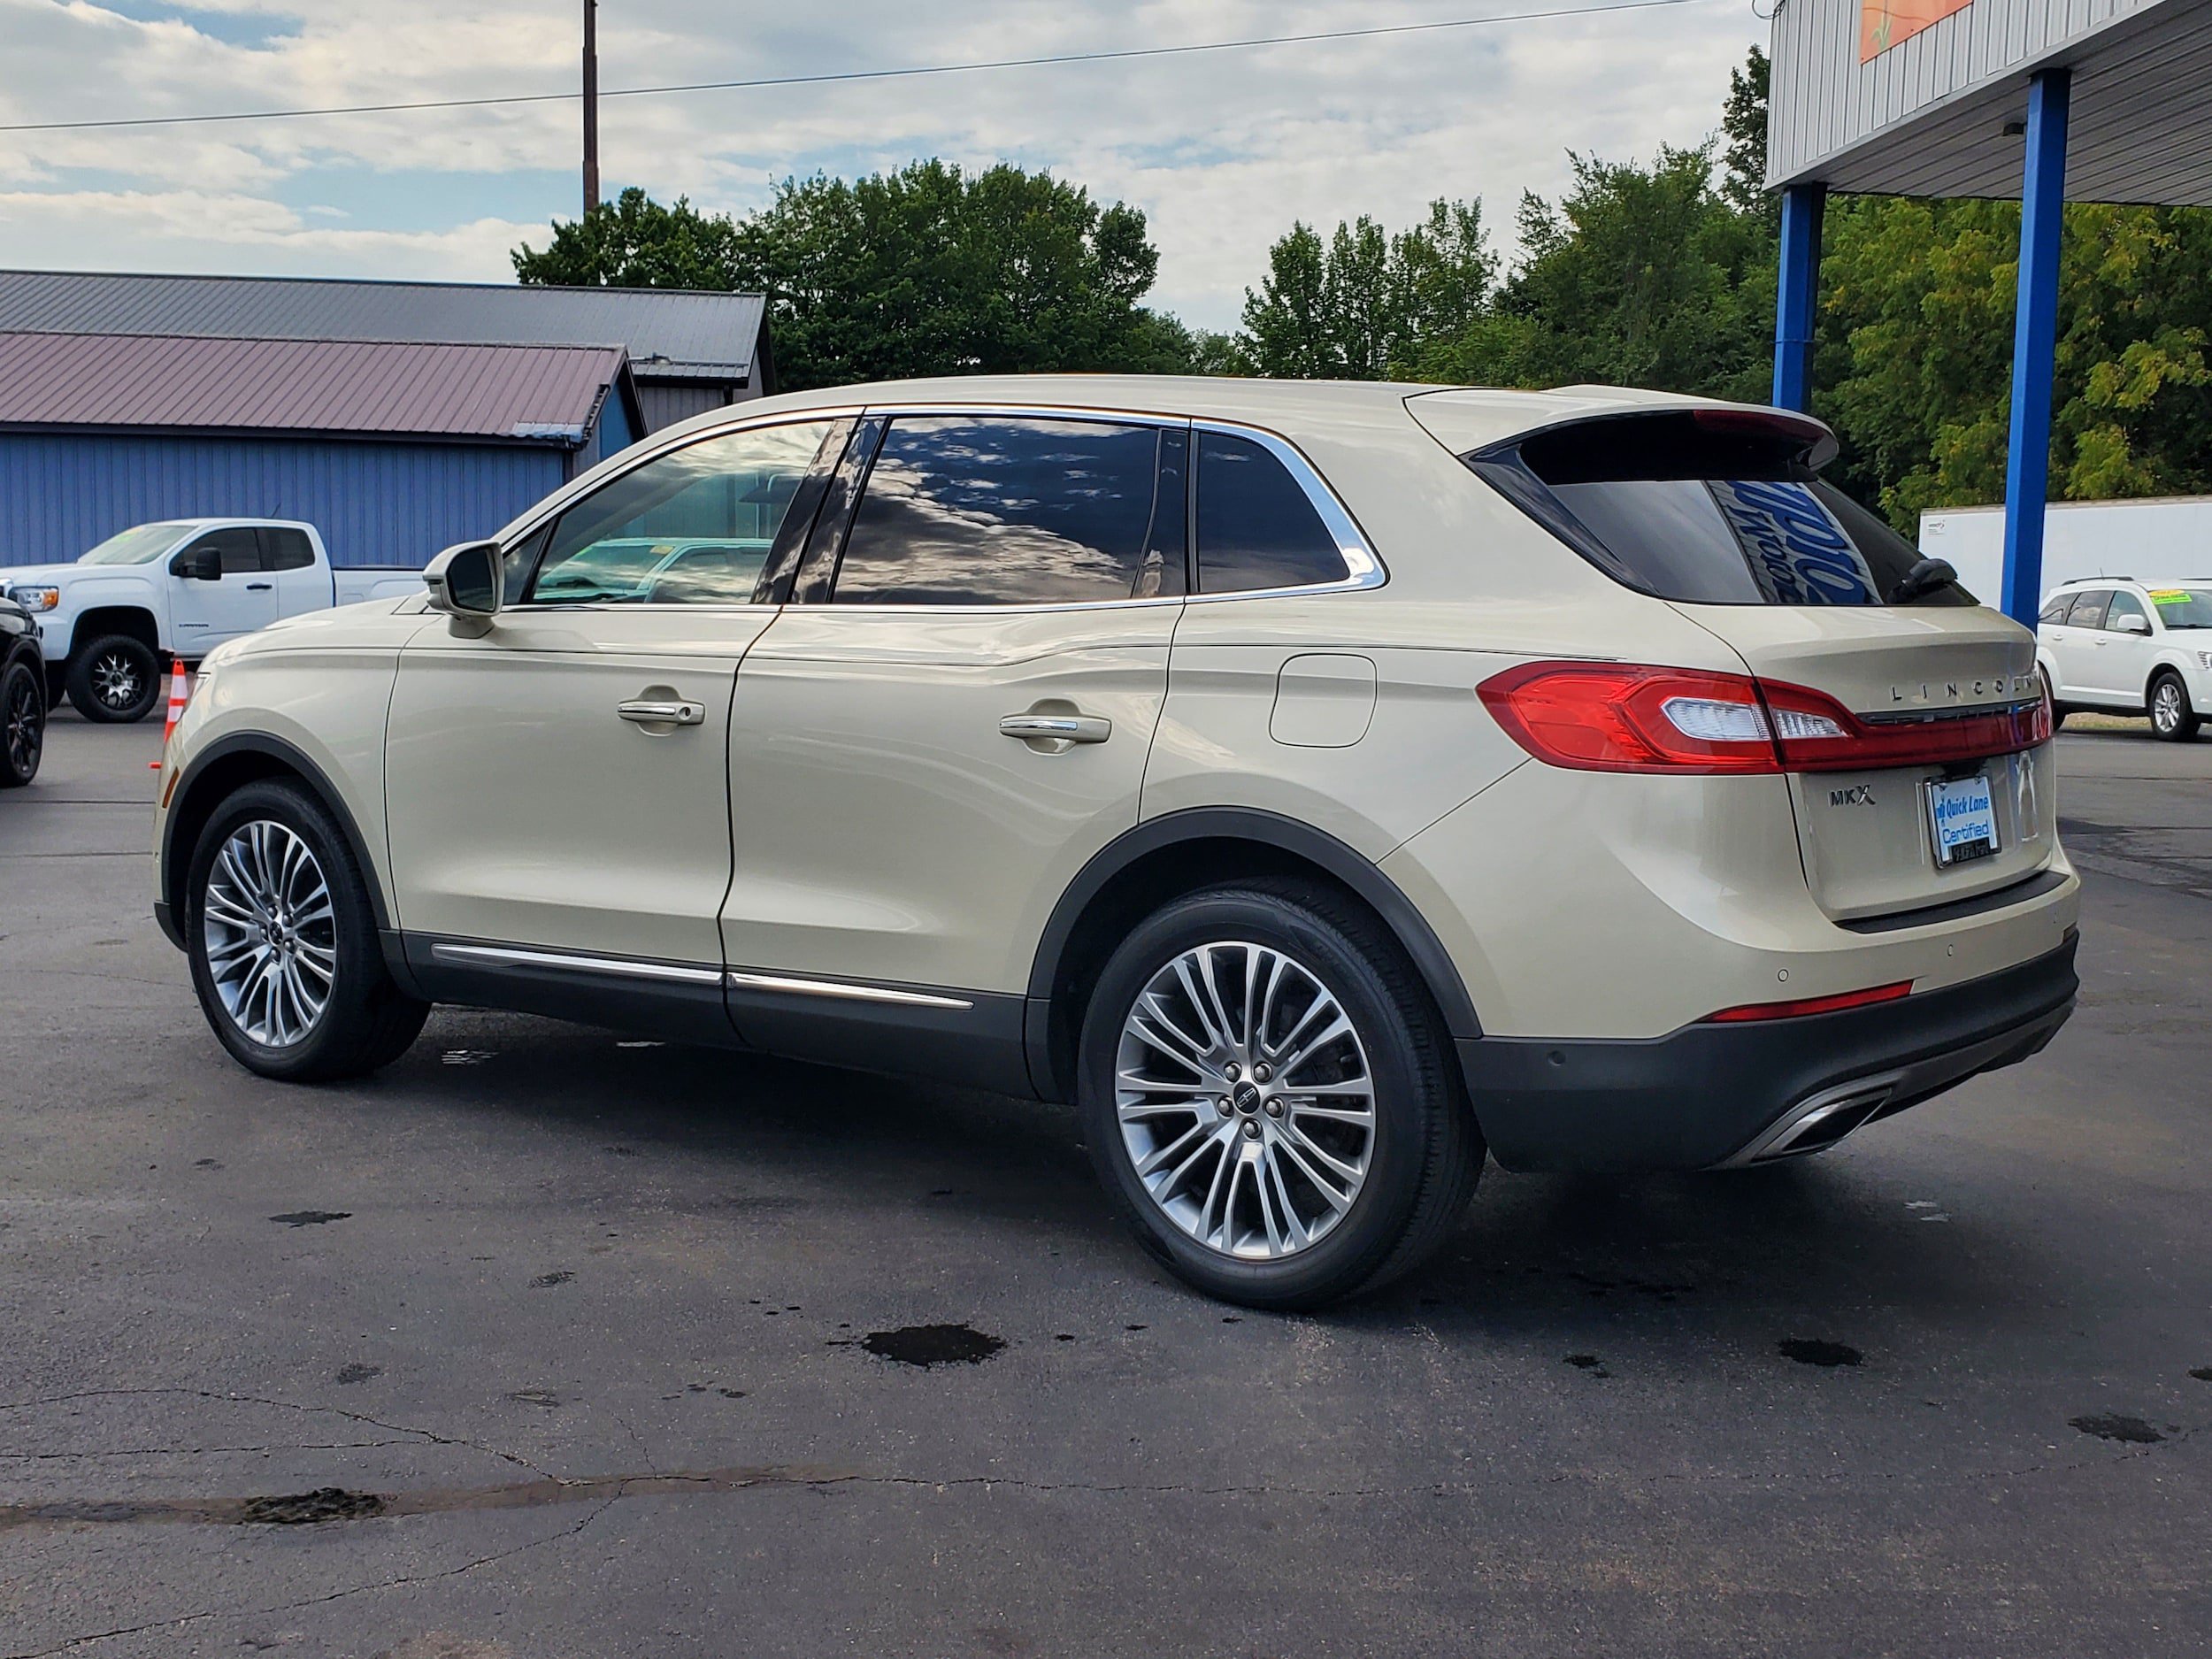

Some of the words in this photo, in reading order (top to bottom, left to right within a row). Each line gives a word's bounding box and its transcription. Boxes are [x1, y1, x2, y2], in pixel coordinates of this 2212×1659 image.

[1890, 678, 2032, 702] LINCOLN
[1830, 784, 1876, 806] MKX
[1947, 797, 1968, 819] Quick
[1969, 795, 1989, 813] Lane
[1942, 819, 1990, 844] Certified
